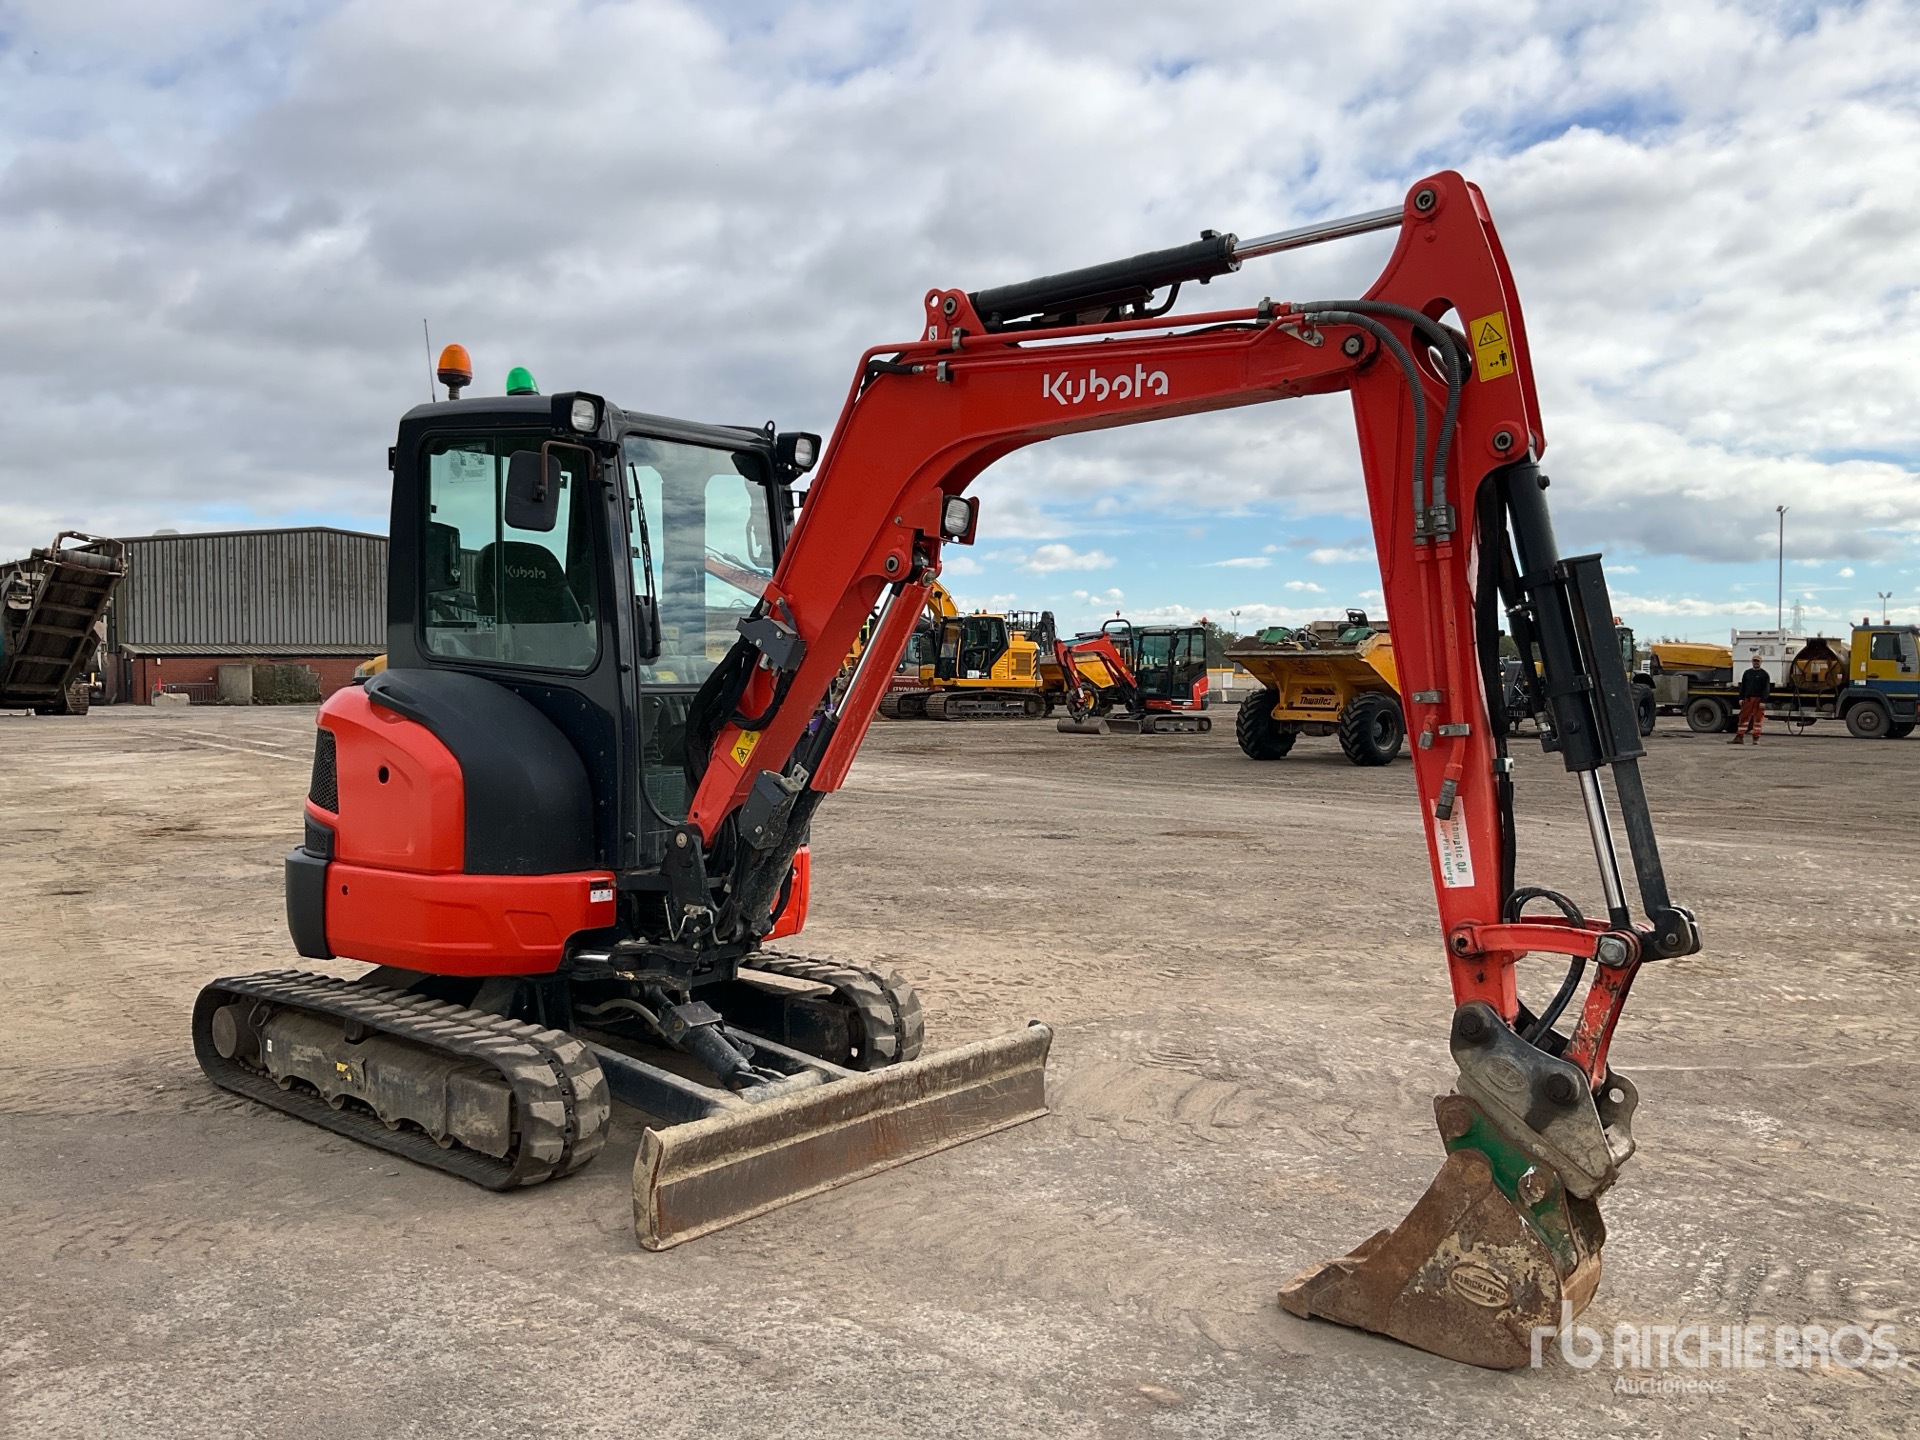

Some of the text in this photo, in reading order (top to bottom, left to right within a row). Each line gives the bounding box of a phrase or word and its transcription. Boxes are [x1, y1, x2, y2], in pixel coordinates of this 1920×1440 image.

[1043, 363, 1169, 405] Kubota
[504, 564, 547, 579] Kubota
[1450, 810, 1467, 873] Automatic QH
[1444, 852, 1456, 885] Required
[1453, 1272, 1506, 1300] STRICKLAND
